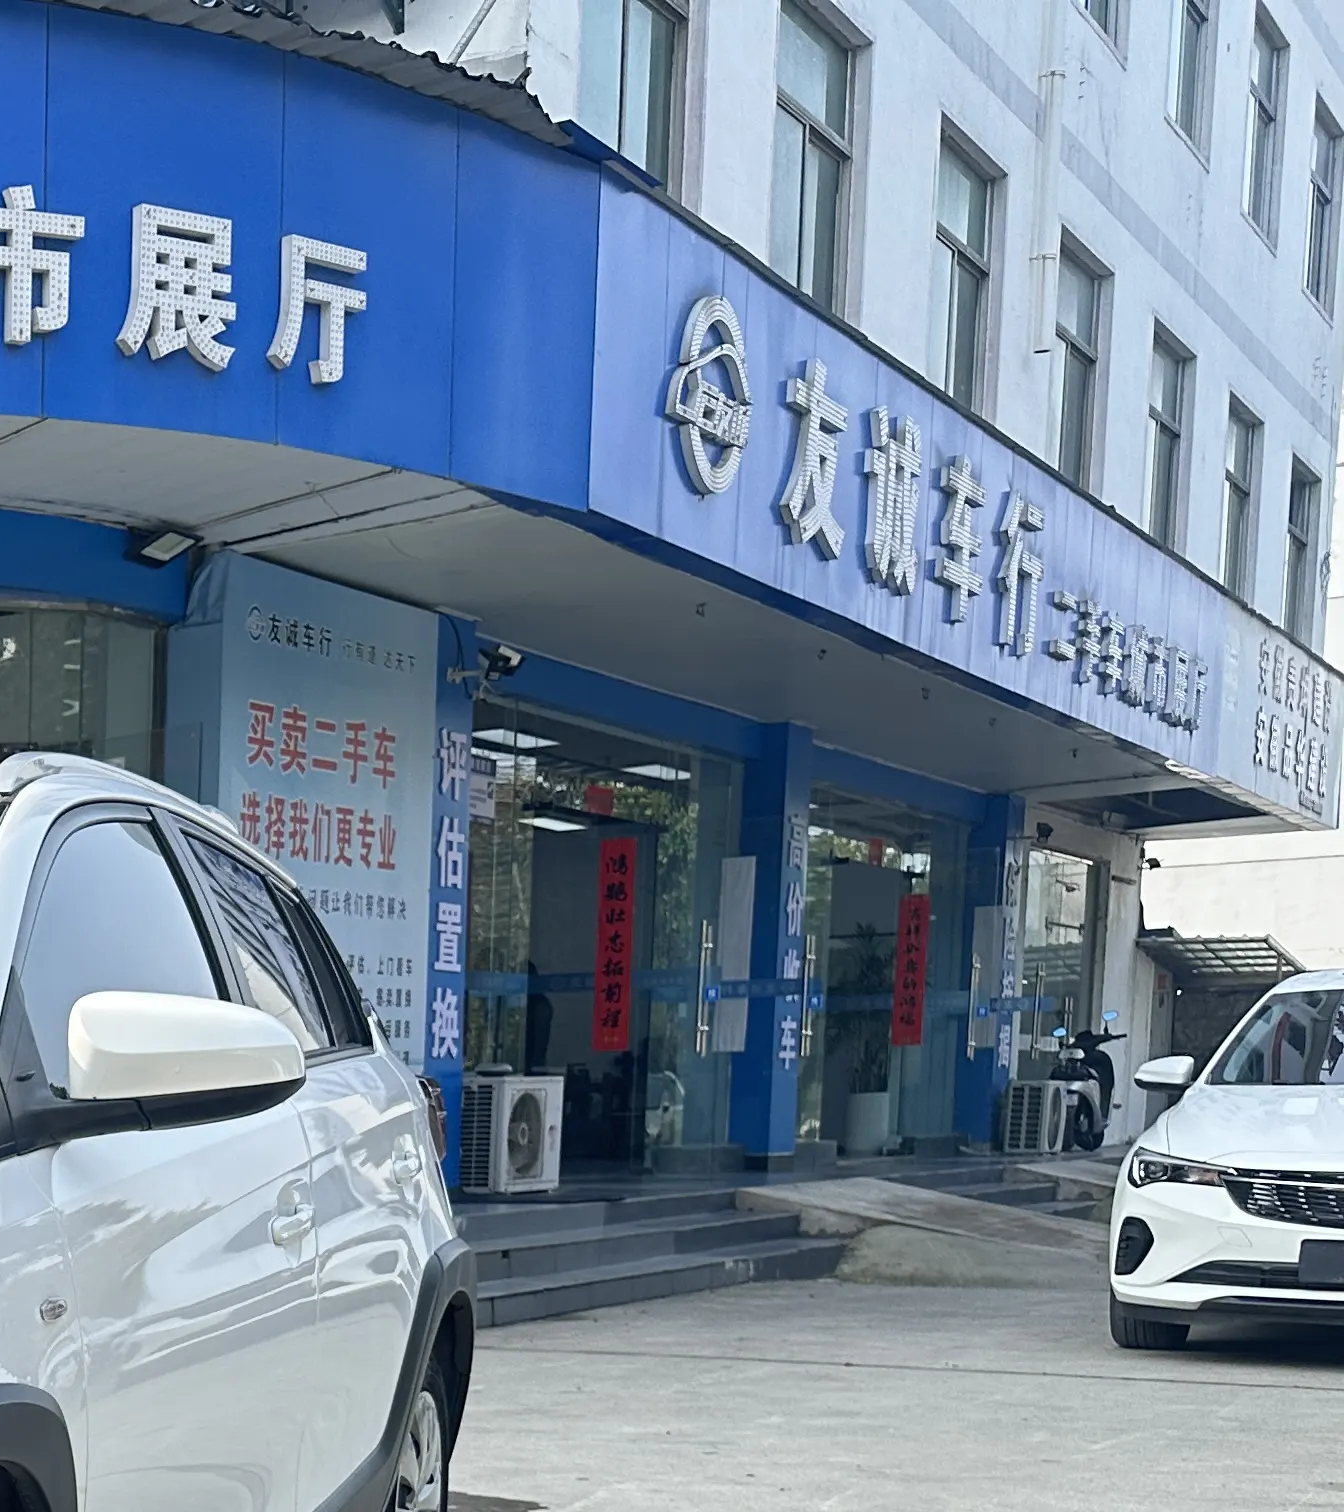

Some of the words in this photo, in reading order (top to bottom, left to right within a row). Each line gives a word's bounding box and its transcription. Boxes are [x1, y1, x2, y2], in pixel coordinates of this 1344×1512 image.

[779, 357, 1045, 659] 友诚车行
[268, 613, 333, 658] 友诚车行
[247, 700, 397, 790] 买卖二手车
[240, 793, 396, 871] 选择我们更专业
[431, 728, 467, 1060] 评估置换
[778, 814, 806, 1071] 高价收车
